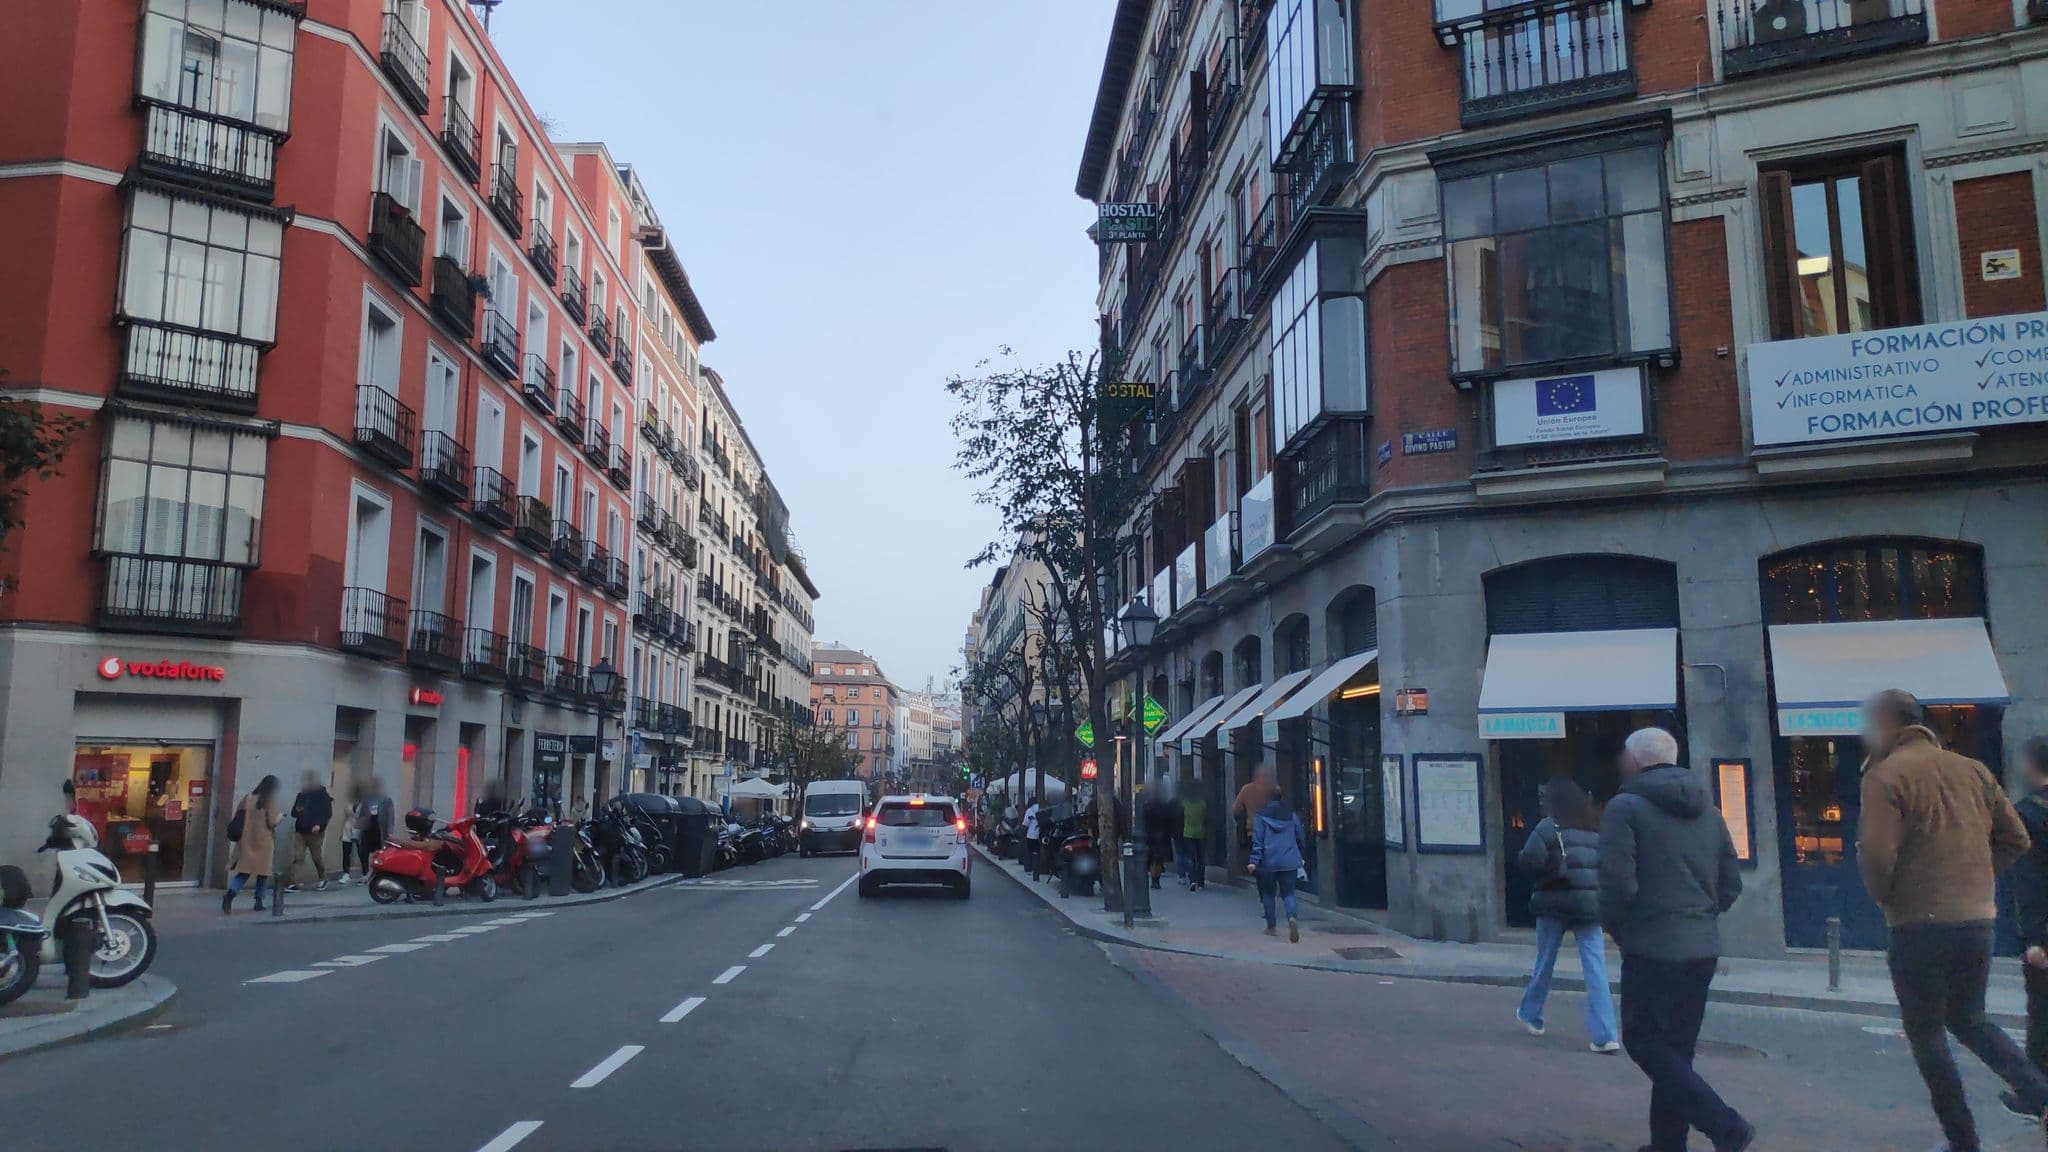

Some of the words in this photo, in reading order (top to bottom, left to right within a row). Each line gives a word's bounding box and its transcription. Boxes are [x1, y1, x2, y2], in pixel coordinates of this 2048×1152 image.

[1100, 204, 1156, 217] HOSTAL
[1119, 231, 1146, 239] PLANTA
[1851, 322, 2006, 358] FORMACIÓN
[2016, 320, 2048, 341] PR
[1792, 358, 1939, 386] ADMINISTRATIVO
[1099, 383, 1154, 398] OSTAL
[1793, 384, 1918, 408] INFORMÁTICA
[1537, 416, 1561, 426] Unión
[1563, 414, 1598, 424] Europea
[1807, 401, 1962, 435] FORMACIÓN
[1972, 396, 2048, 420] PROFE
[1405, 443, 1428, 454] DIVINO
[1430, 440, 1456, 451] PASTOR
[127, 660, 224, 681] vodafone
